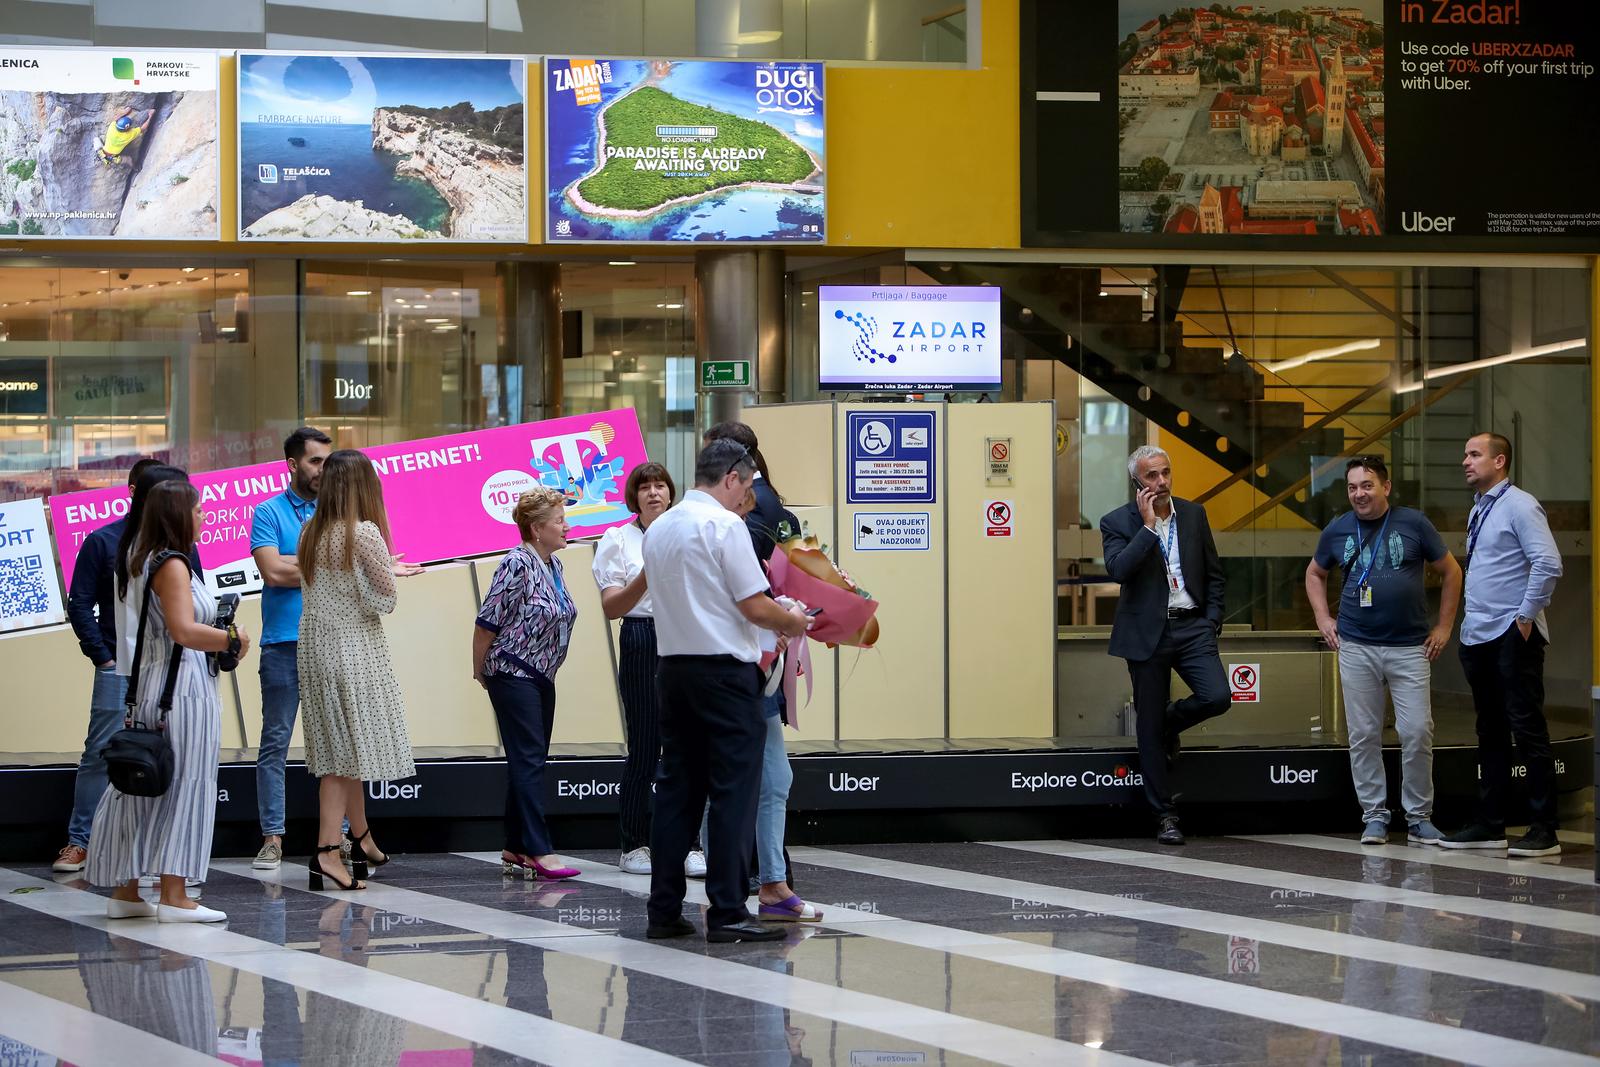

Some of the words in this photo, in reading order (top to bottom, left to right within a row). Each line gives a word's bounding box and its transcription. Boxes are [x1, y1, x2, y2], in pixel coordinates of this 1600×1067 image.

[1401, 0, 1424, 23] in
[1432, 0, 1520, 24] Zadar!
[1401, 41, 1428, 55] Use
[1432, 42, 1469, 56] code
[1471, 42, 1575, 57] UBERXZADAR
[0, 59, 40, 69] ENICA
[147, 62, 183, 70] PARKOVI
[1401, 60, 1416, 72] to
[1420, 60, 1444, 75] get
[1447, 60, 1481, 72] 70%
[1483, 60, 1504, 73] off
[1506, 63, 1538, 77] your
[1541, 61, 1567, 75] first
[1570, 62, 1594, 78] trip
[756, 70, 815, 89] DUGI
[1401, 76, 1430, 90] with
[1434, 76, 1471, 90] Uber.
[756, 88, 815, 106] OTOK
[258, 115, 303, 123] EMBRACE
[306, 115, 344, 123] NATURE
[607, 147, 679, 159] PARADISE
[684, 147, 697, 159] IS
[701, 148, 767, 160] ALREADY
[634, 159, 705, 171] AWAITING
[710, 160, 740, 171] YOU
[25, 211, 117, 221] www.np-paklenica.hr
[1402, 211, 1456, 232] Uber
[1499, 212, 1529, 220] promotion
[871, 291, 903, 301] Prtljaga
[911, 291, 948, 301] Baggage
[892, 322, 986, 338] ZADAR
[896, 344, 983, 352] AIRPORT
[334, 378, 373, 399] Dior
[65, 497, 132, 524] ENJO
[201, 482, 228, 504] AY
[233, 472, 291, 498] UNLI
[370, 443, 482, 476] NTERNET!
[489, 481, 511, 489] PROMO
[511, 478, 528, 486] PRICE
[488, 490, 509, 506] 10
[204, 507, 239, 525] ORK
[896, 518, 926, 526] OBJEKT
[200, 525, 249, 546] OATIA
[1010, 772, 1077, 793] Explore
[1080, 770, 1144, 789] Croatia
[1269, 765, 1319, 784] Uber
[368, 780, 422, 800] Uber
[558, 780, 621, 800] Explore
[828, 773, 880, 793] Uber
